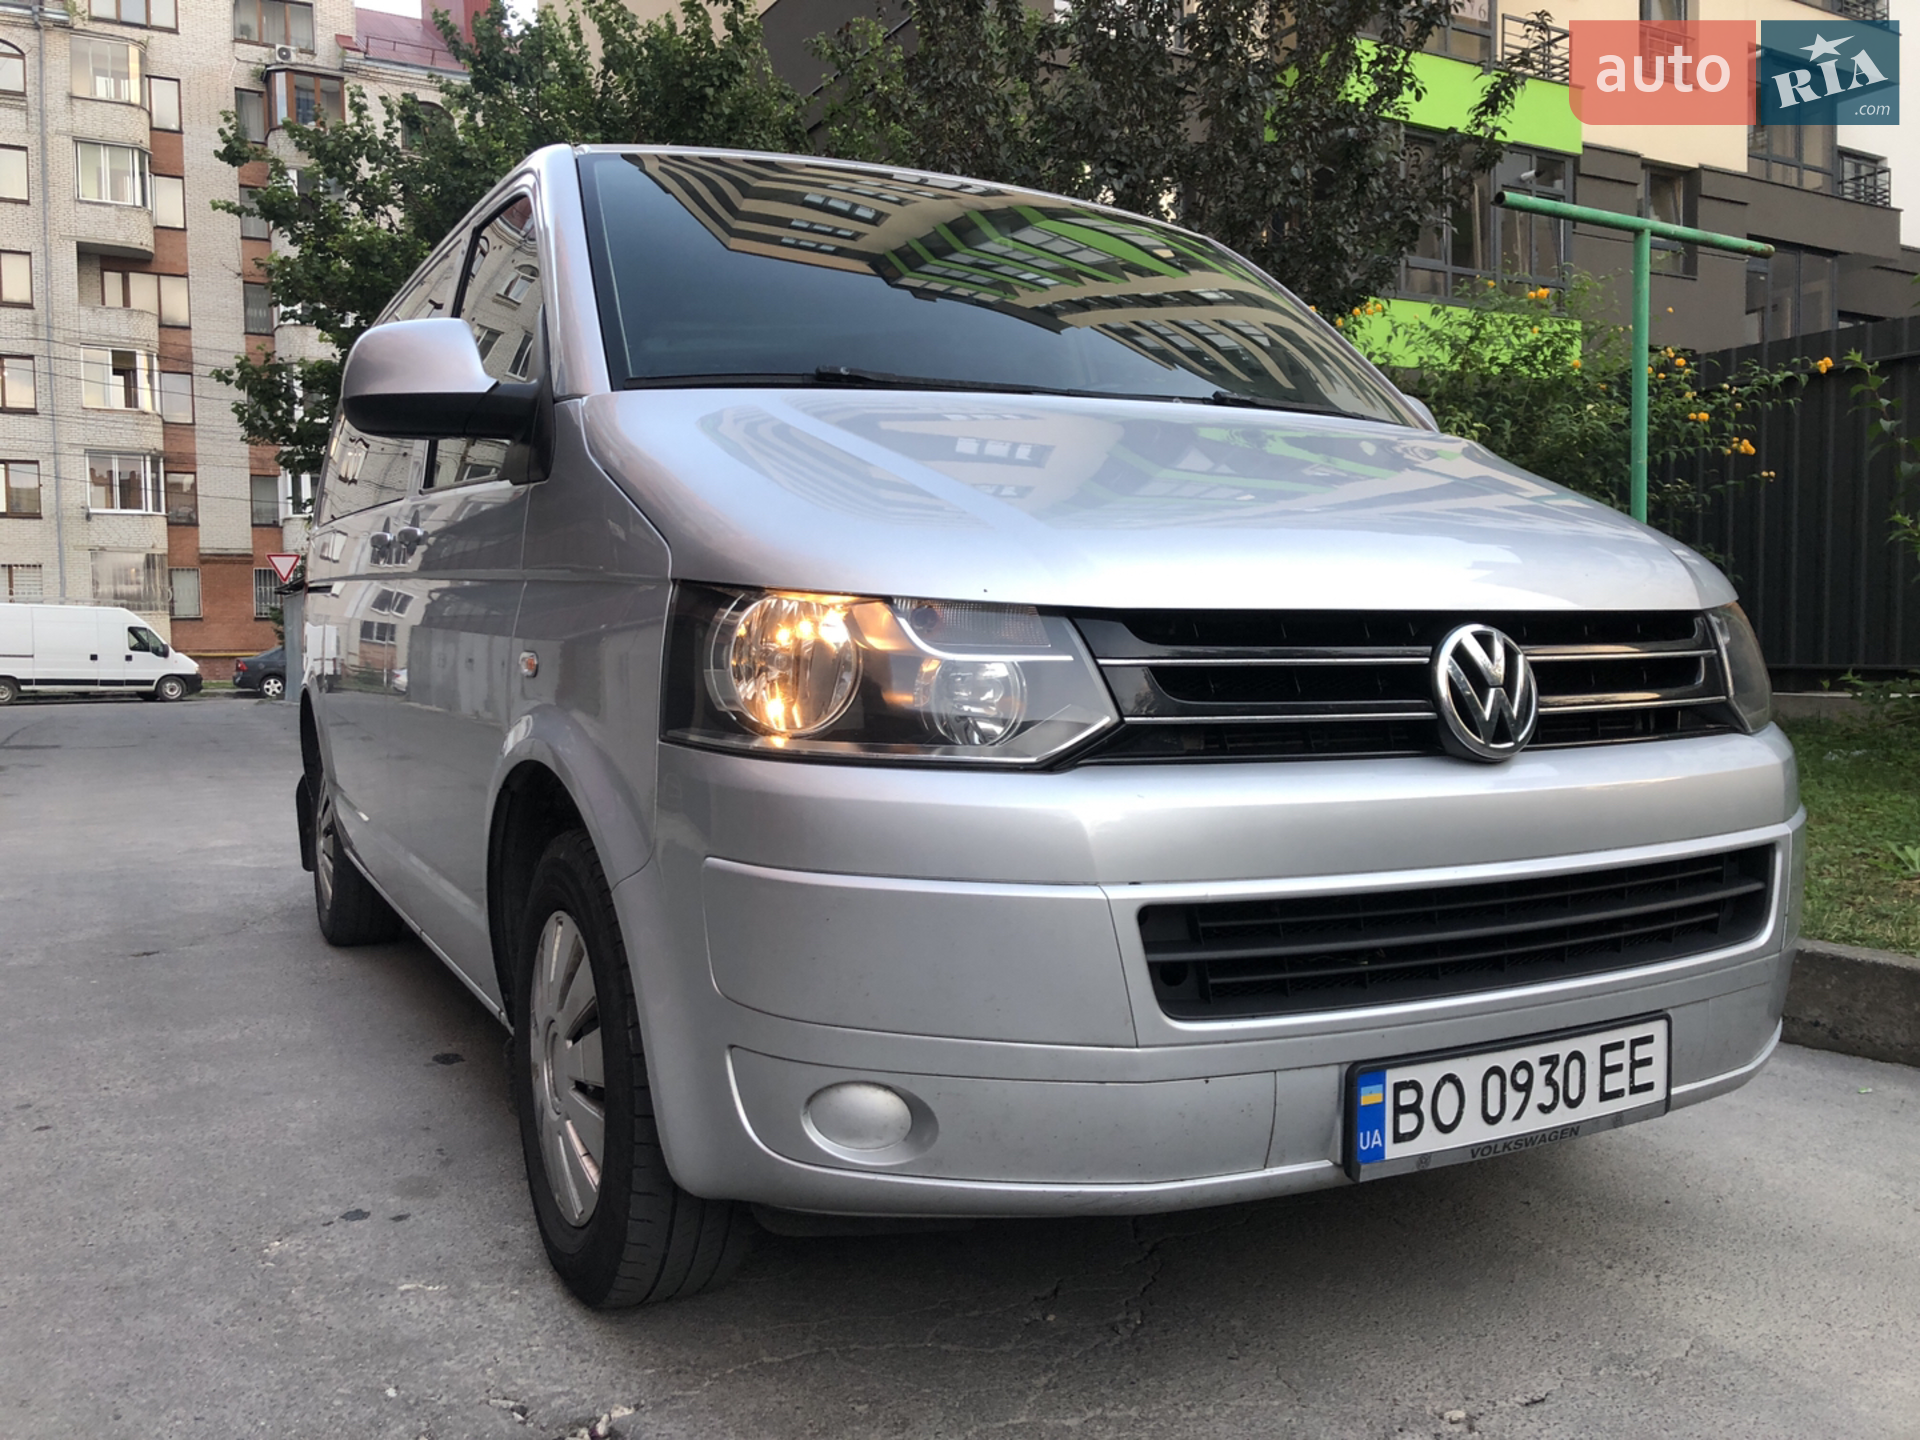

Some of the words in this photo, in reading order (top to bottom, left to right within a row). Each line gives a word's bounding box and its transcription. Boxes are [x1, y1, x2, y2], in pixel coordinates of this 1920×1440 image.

[1393, 1073, 1466, 1143] BO
[1481, 1050, 1586, 1125] 0930
[1600, 1034, 1654, 1102] EE
[1360, 1129, 1382, 1150] UA
[1470, 1126, 1580, 1159] VOLKSWAGEN
